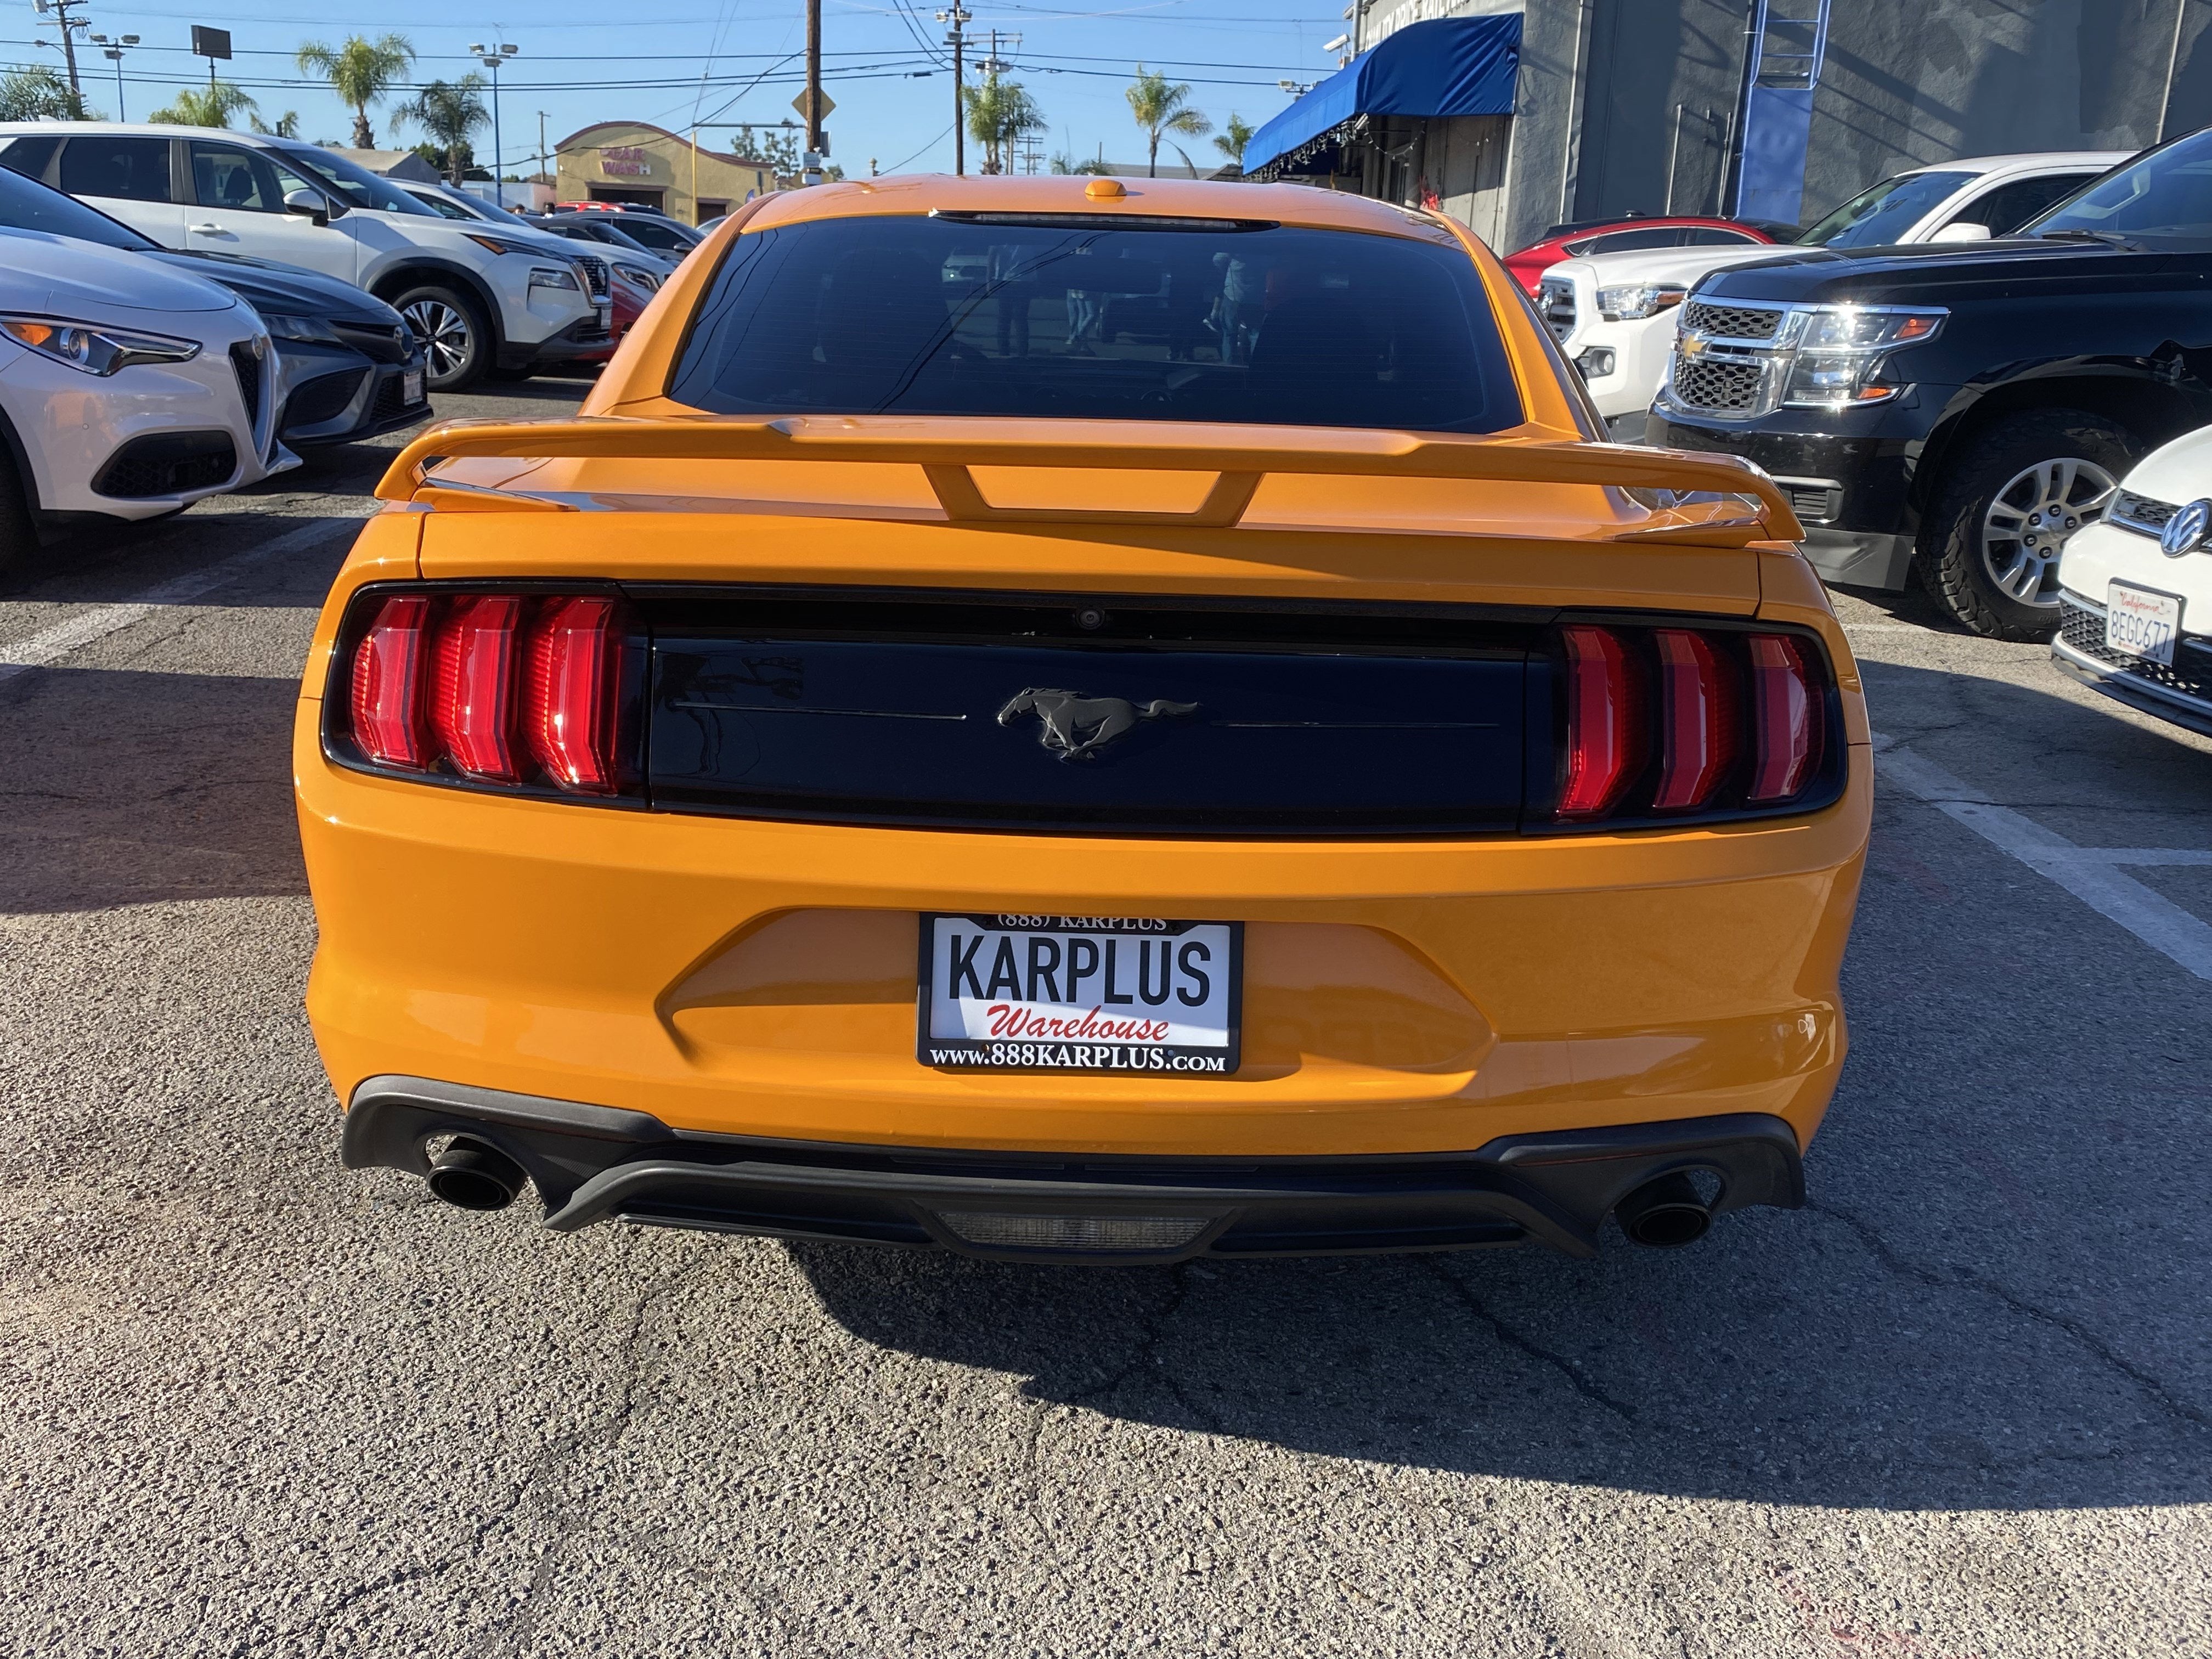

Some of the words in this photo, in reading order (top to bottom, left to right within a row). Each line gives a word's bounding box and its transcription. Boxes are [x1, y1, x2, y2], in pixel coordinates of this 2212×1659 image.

[602, 161, 651, 176] WASH
[2112, 610, 2170, 654] 8EGC677
[949, 934, 1211, 1007] KARPLUS
[986, 1005, 1169, 1041] Warehouse
